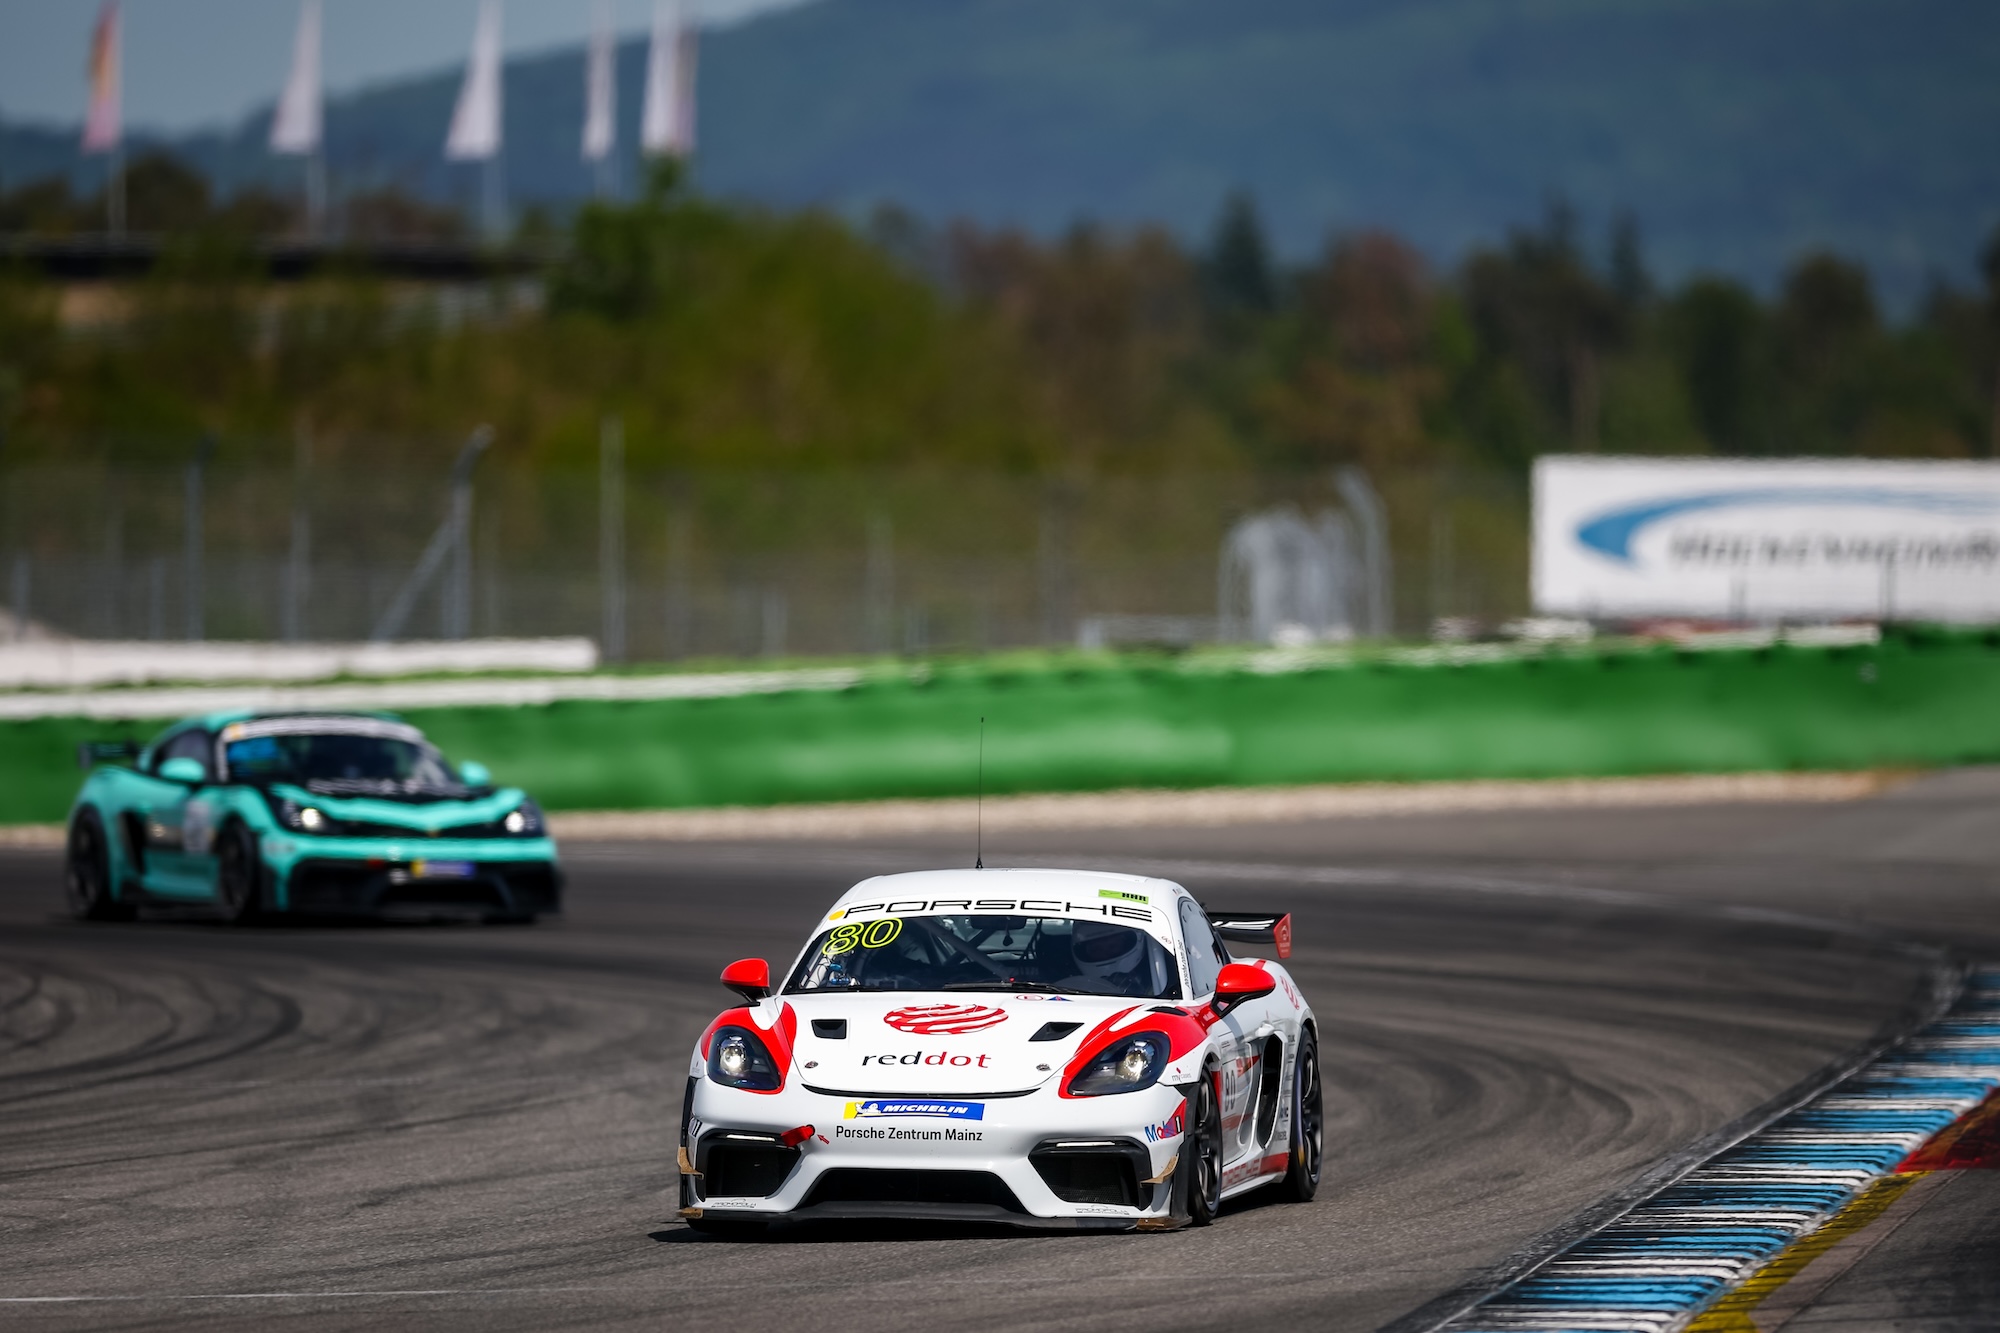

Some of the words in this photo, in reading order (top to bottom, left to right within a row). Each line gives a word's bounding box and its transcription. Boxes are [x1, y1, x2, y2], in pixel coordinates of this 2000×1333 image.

[843, 899, 1152, 923] PORSCHE
[822, 917, 903, 955] 80
[862, 1051, 992, 1068] reddot
[882, 1103, 968, 1114] MICHELIN
[836, 1126, 885, 1139] Porsche
[888, 1127, 942, 1140] Zentrum
[945, 1129, 983, 1141] Mainz
[1175, 1115, 1183, 1134] 1
